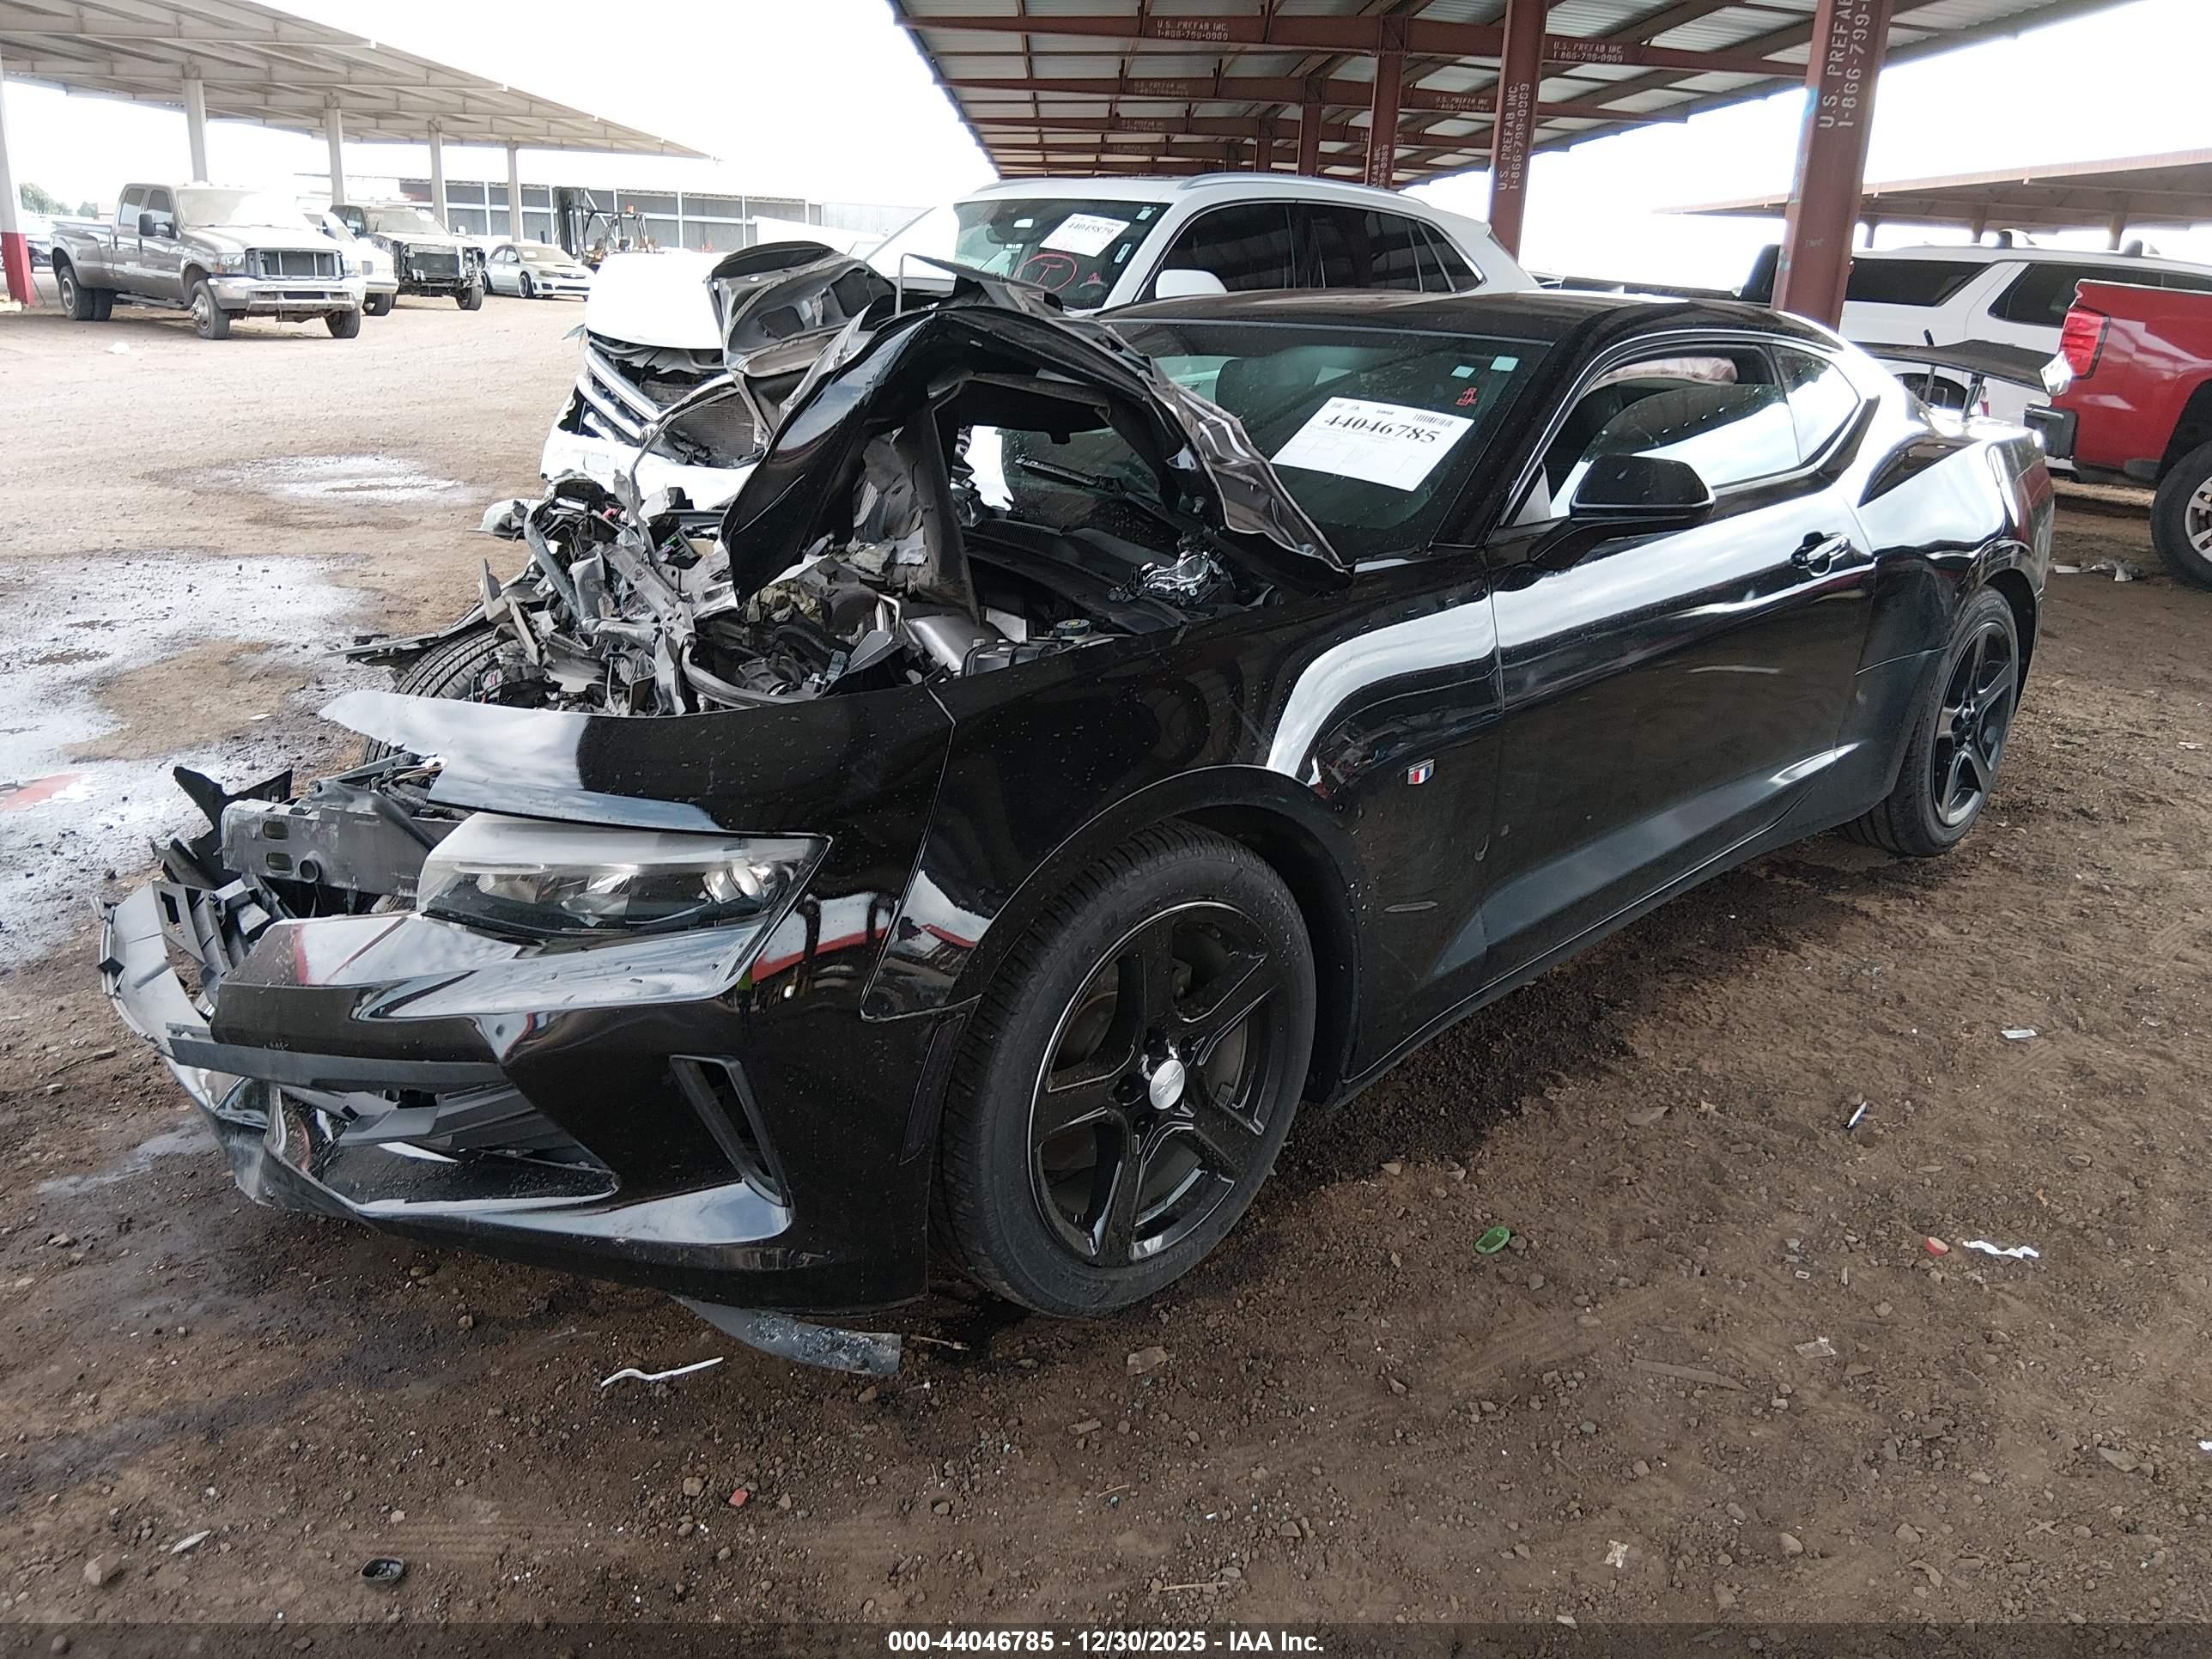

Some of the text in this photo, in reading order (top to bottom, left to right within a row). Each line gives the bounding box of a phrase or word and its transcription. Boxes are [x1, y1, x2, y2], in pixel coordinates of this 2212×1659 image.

[1818, 88, 1839, 129] U.S.
[1501, 112, 1516, 161] PREFAB
[1509, 82, 1530, 190] 1-866-799-0969
[1498, 166, 1510, 191] U.S.
[1324, 414, 1441, 444] 44046785
